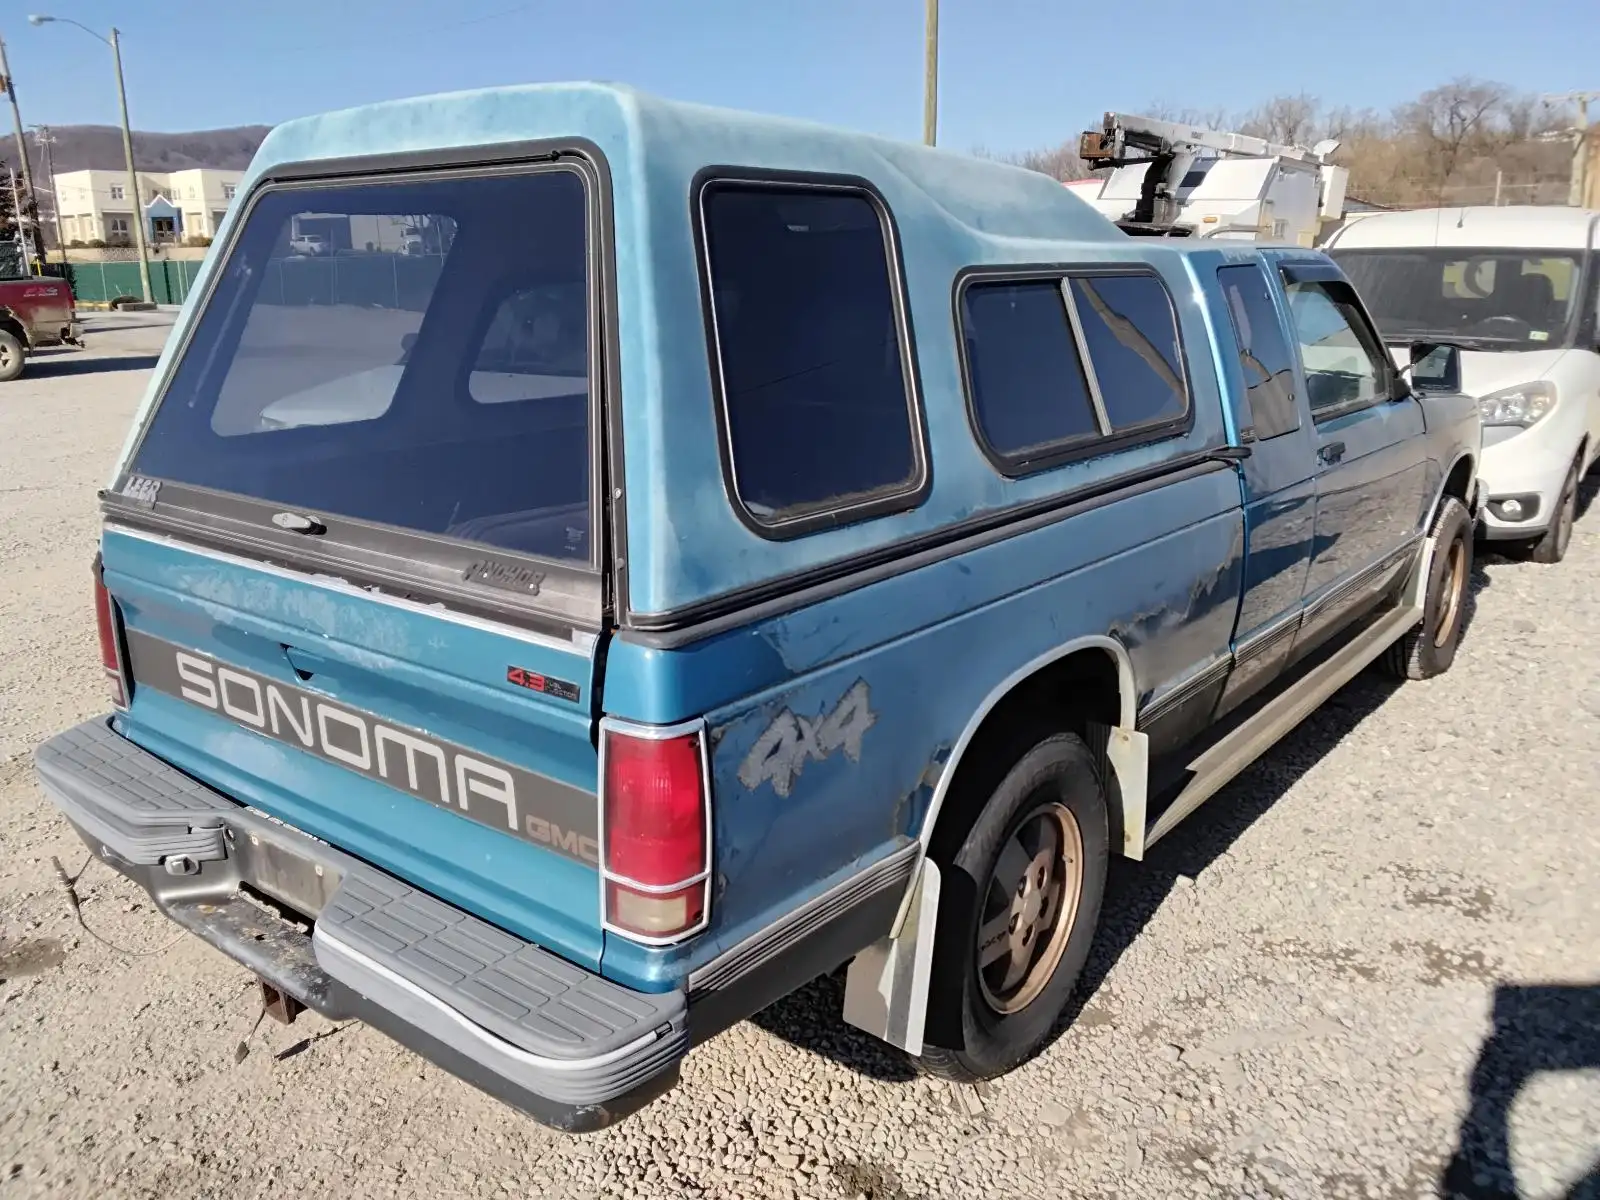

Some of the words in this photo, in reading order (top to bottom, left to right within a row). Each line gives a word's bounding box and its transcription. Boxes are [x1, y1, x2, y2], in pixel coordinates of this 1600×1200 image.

[123, 476, 161, 502] LEER
[508, 669, 545, 692] 4.3
[176, 651, 519, 831] SONOMA
[525, 813, 599, 864] GMC
